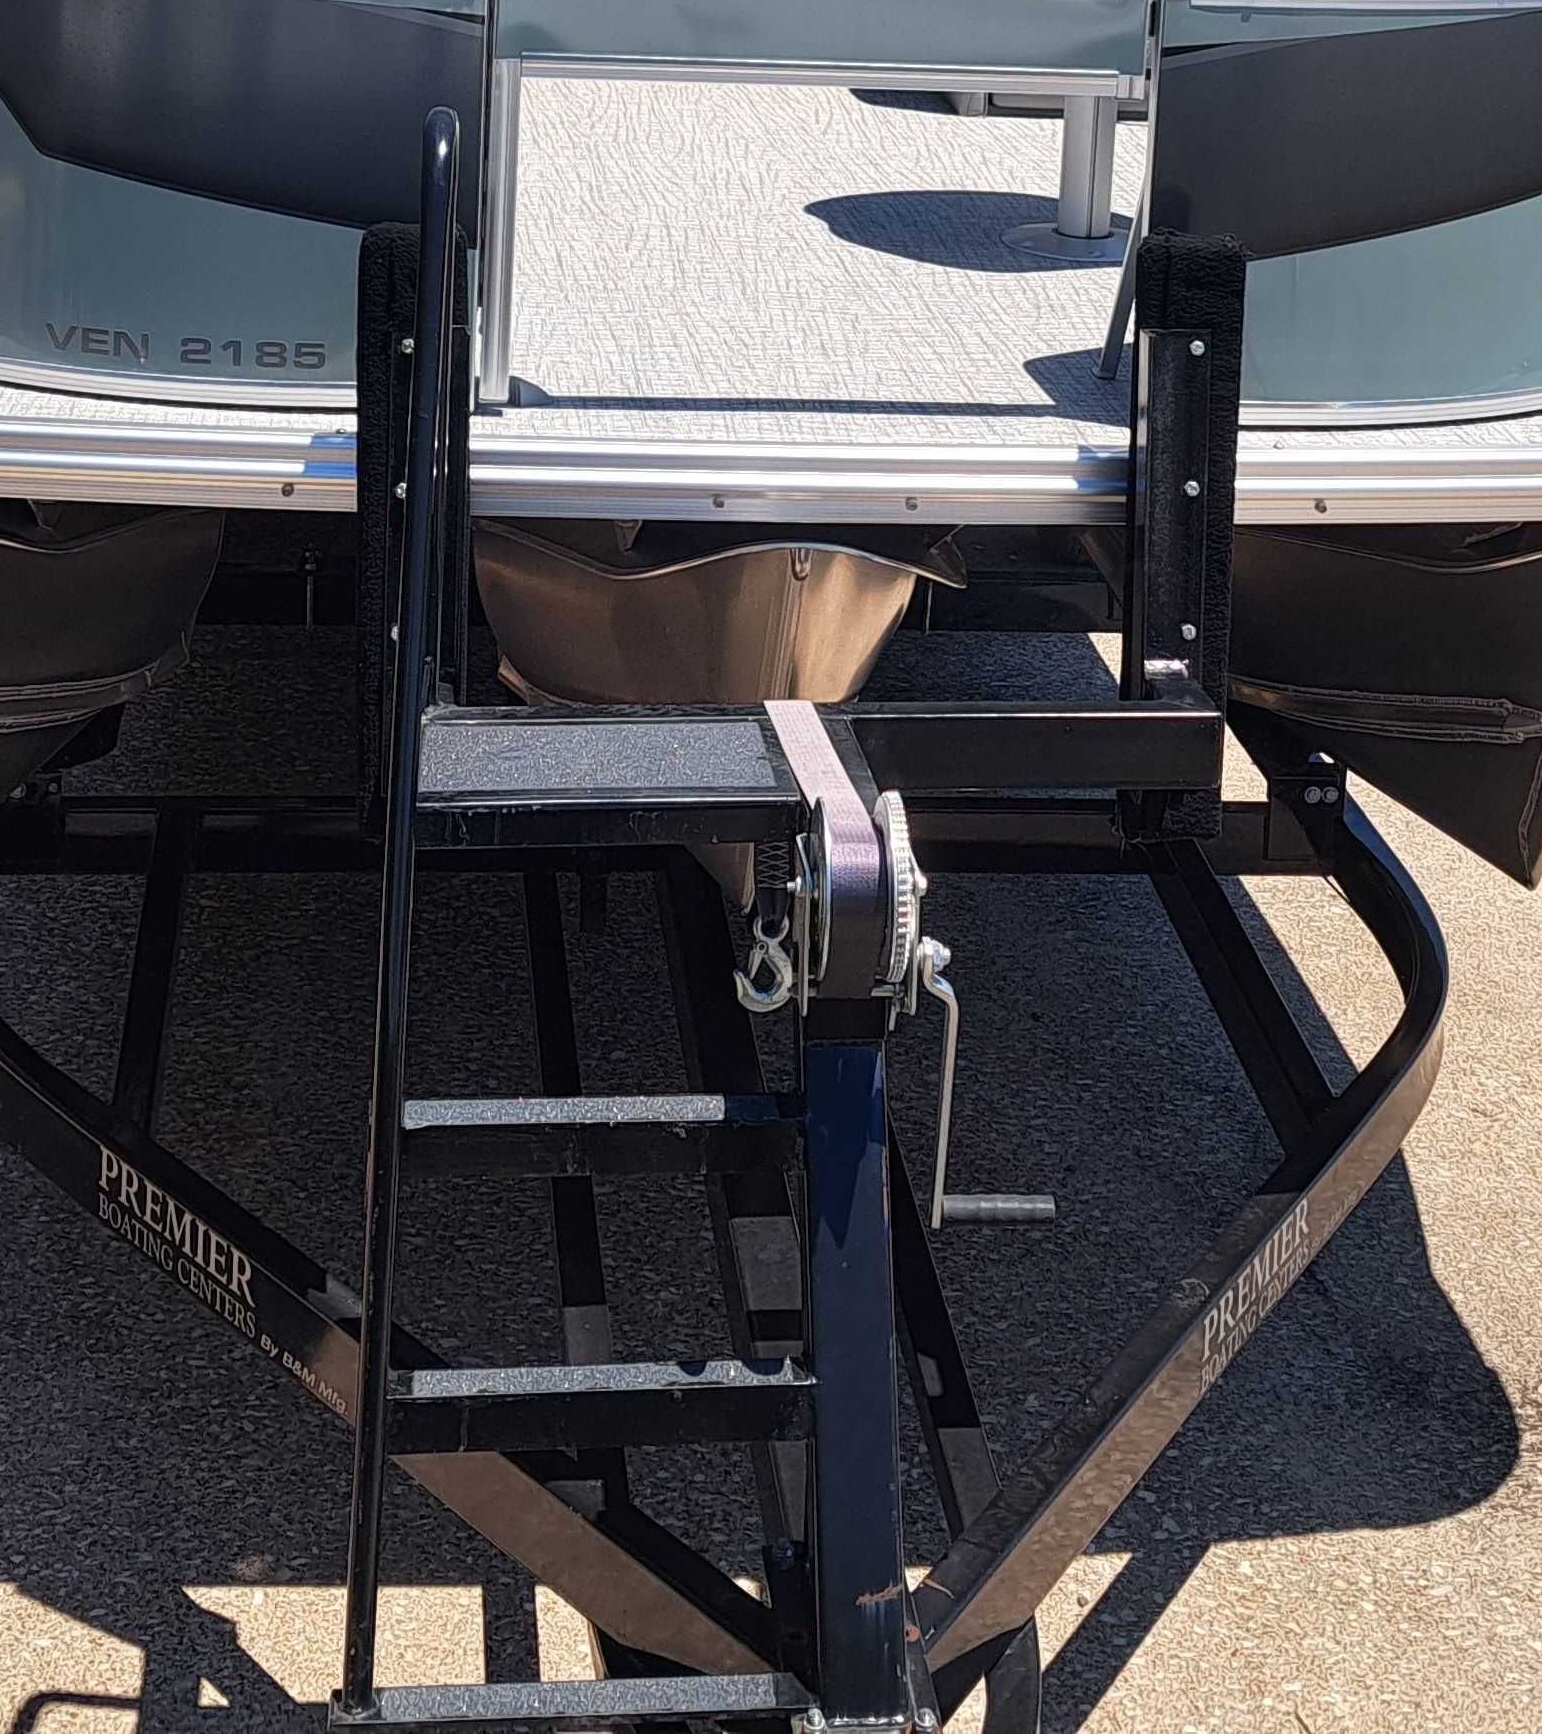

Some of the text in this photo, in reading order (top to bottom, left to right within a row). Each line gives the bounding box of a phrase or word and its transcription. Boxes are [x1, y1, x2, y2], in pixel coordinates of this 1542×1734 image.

[44, 321, 327, 370] VEN 2185
[98, 1144, 257, 1308] PREMIER
[98, 1192, 174, 1271] BOATING
[177, 1258, 256, 1339] CENTERS
[260, 1333, 280, 1358] By
[282, 1351, 316, 1387] B&M
[1201, 1196, 1310, 1364] PREMIER
[1199, 1239, 1310, 1397] BOATING CENTERS
